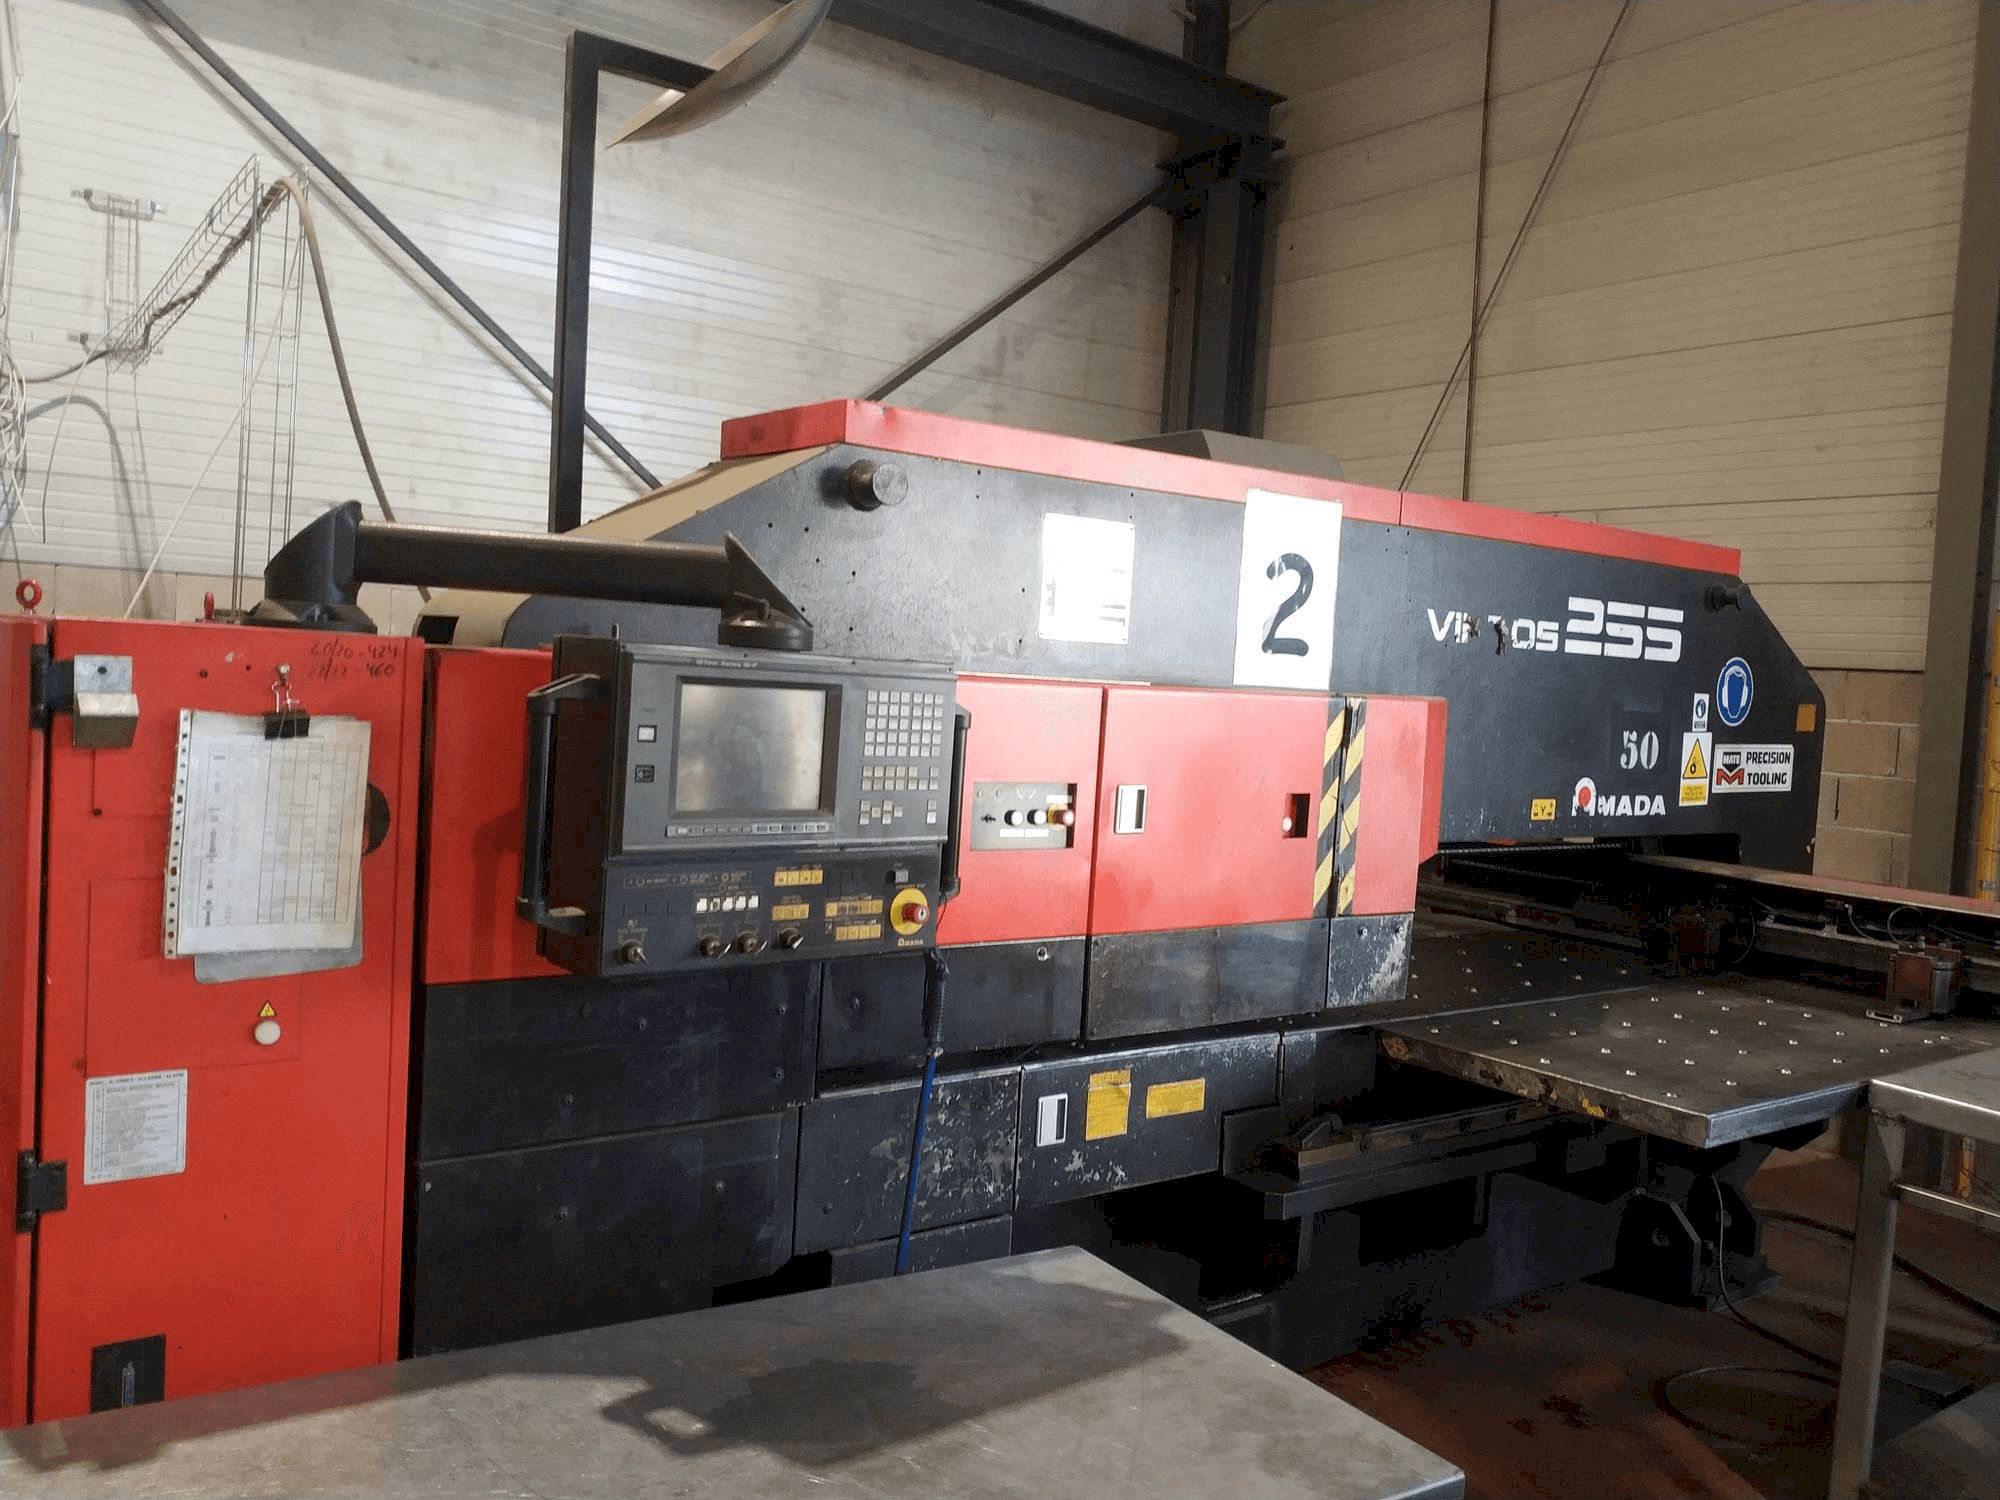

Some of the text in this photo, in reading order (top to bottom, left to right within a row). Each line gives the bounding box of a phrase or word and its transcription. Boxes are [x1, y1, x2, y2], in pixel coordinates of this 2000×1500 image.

[1262, 553, 1314, 657] 2
[1564, 596, 1684, 663] 255
[1620, 730, 1659, 769] 50
[1746, 751, 1791, 765] PRECISION
[1747, 772, 1787, 785] TOOLING
